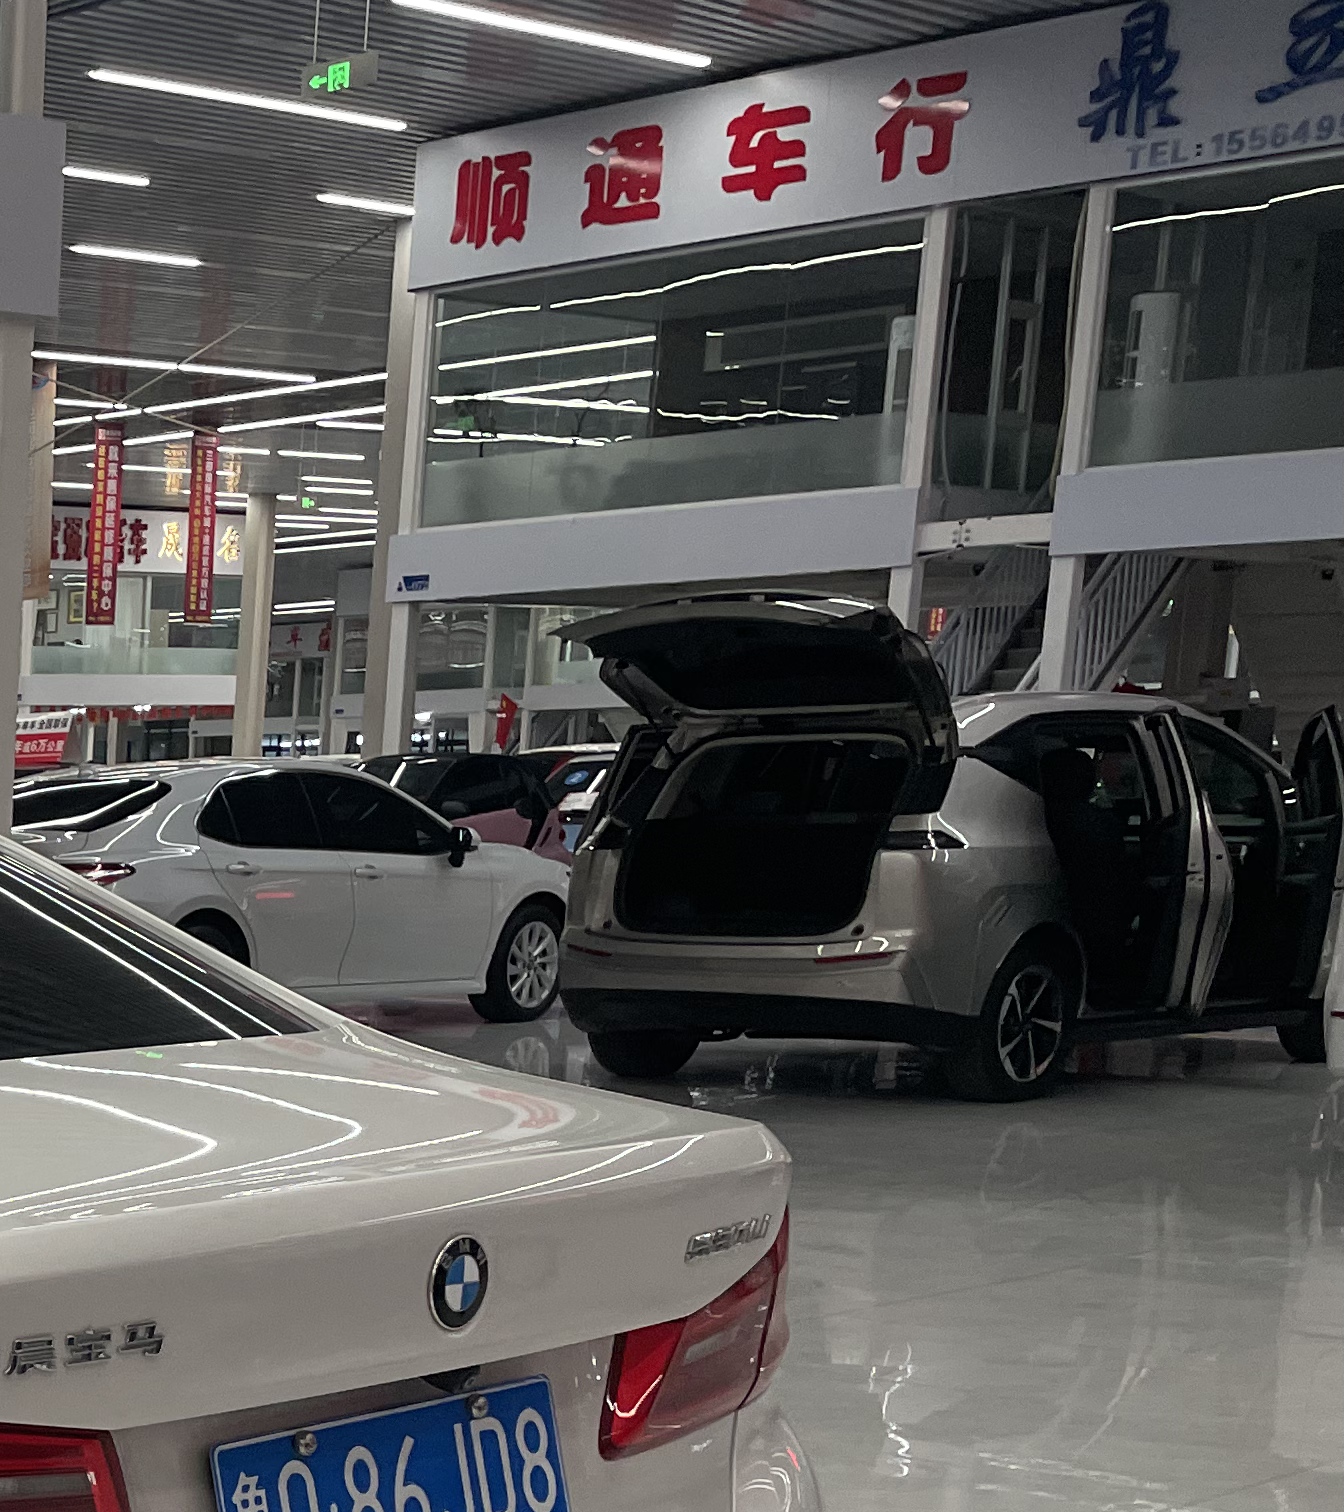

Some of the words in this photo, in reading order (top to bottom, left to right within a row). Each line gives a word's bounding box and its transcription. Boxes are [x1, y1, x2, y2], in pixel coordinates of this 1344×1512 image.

[449, 71, 972, 250] 顺通车行
[1126, 113, 1344, 170] TEL:155649
